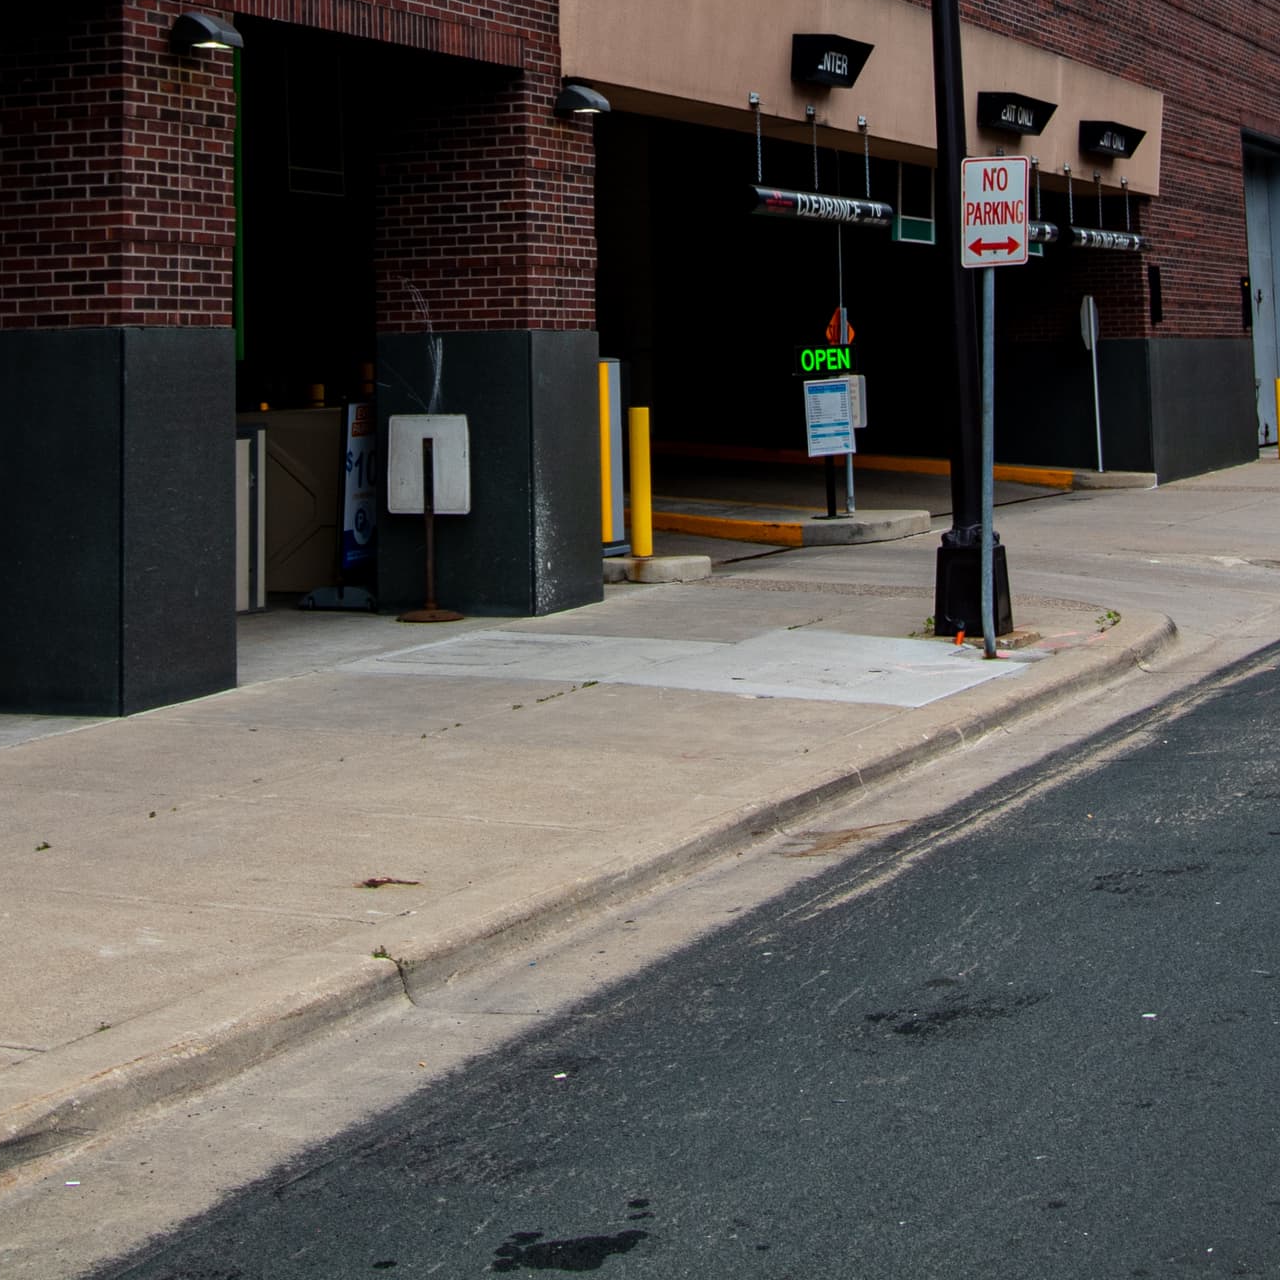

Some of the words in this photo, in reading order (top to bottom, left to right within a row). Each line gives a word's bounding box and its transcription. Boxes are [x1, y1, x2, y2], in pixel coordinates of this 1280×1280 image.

[982, 167, 1008, 192] NO
[796, 193, 861, 222] CLEARANCE
[966, 200, 1024, 226] PARKING
[801, 347, 851, 371] OPEN
